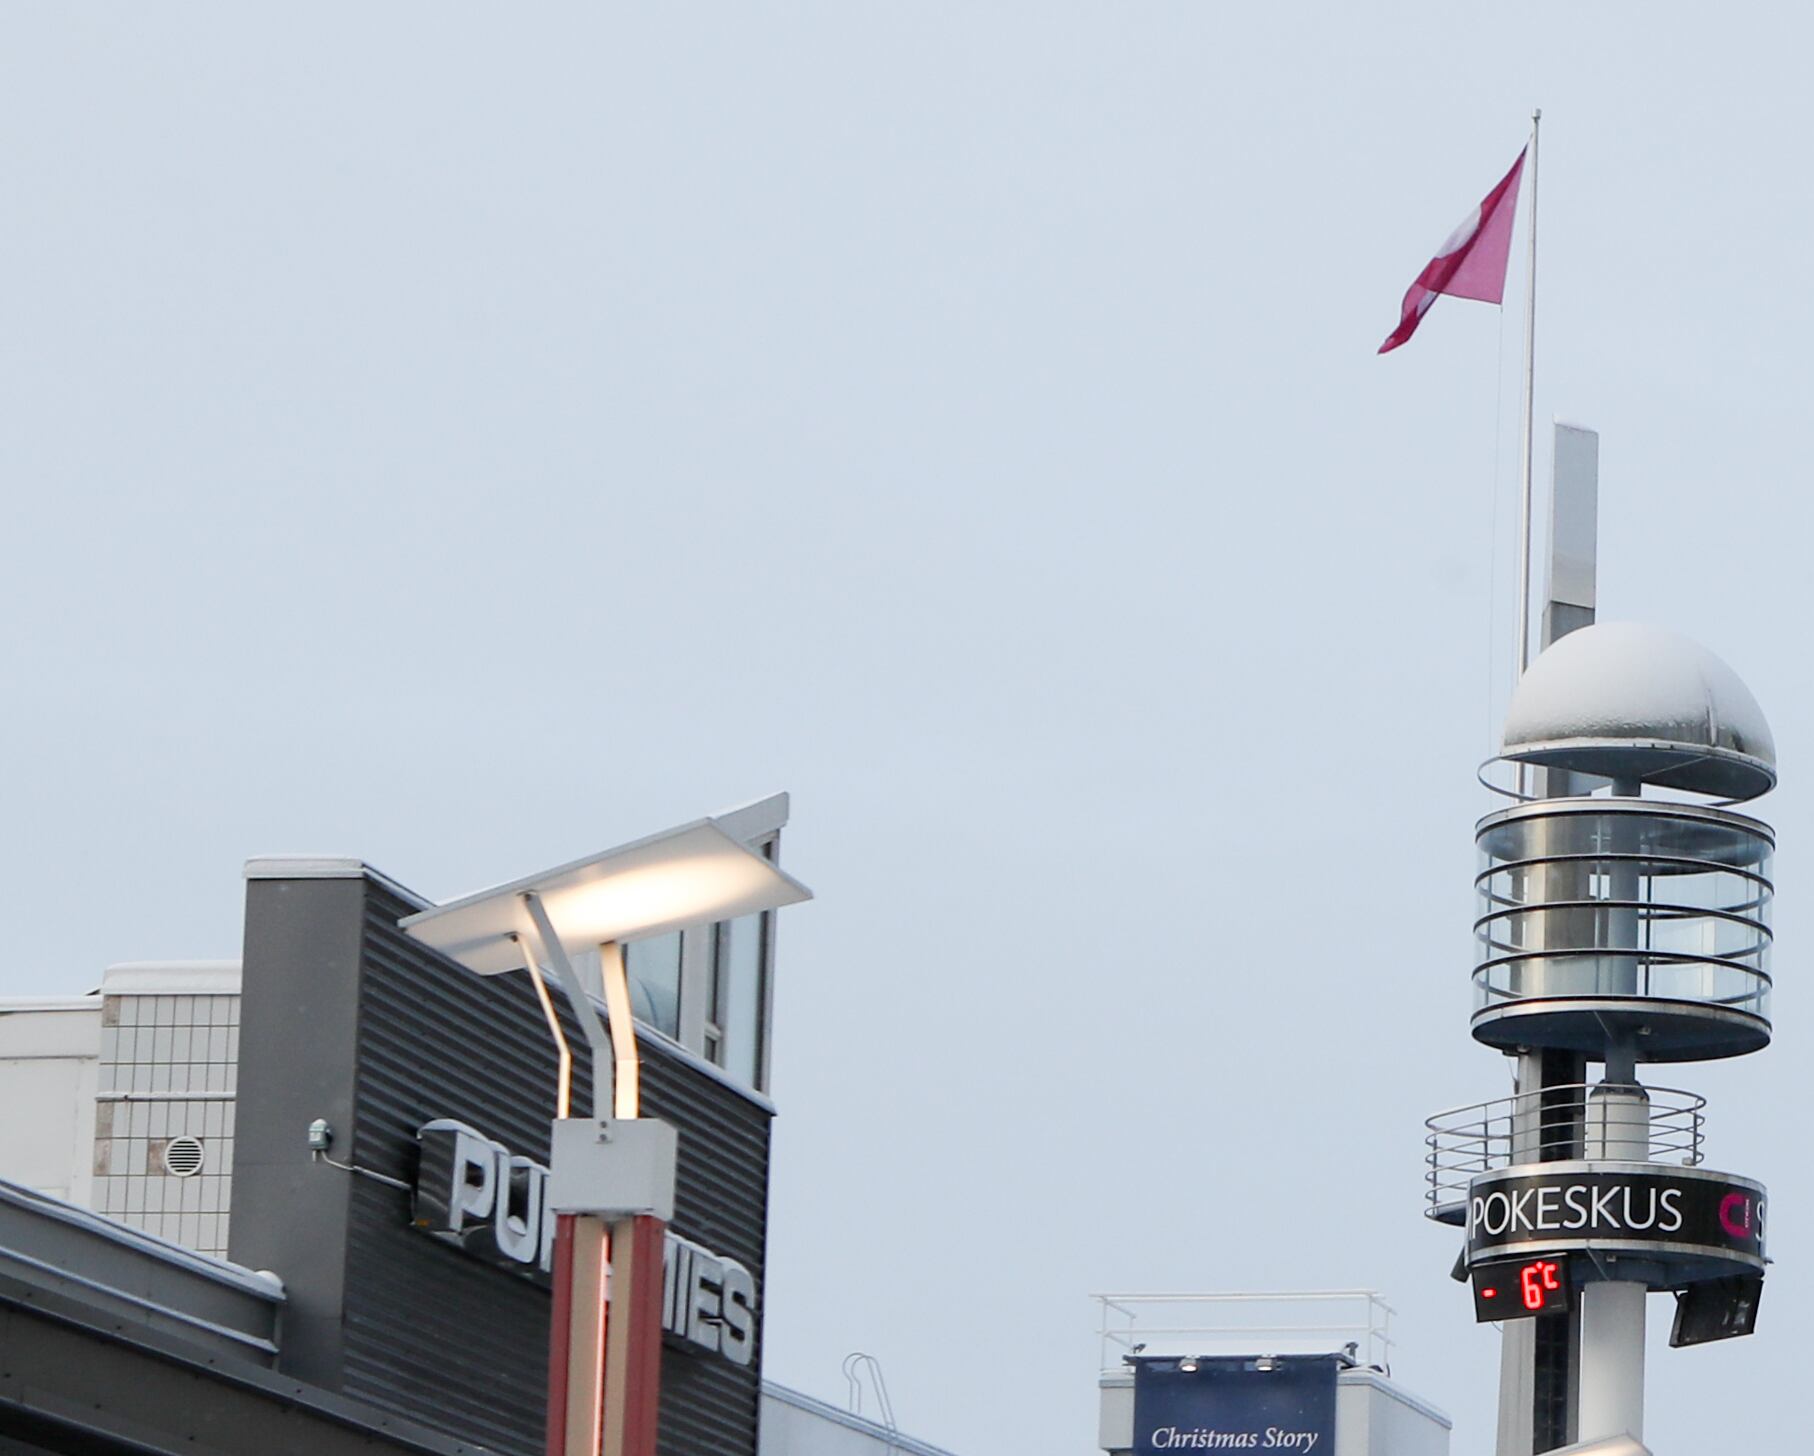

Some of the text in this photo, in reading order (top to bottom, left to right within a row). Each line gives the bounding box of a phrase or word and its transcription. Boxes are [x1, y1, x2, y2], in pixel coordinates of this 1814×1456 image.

[449, 1119, 756, 1366] PUIES
[1152, 1427, 1318, 1454] Christmas Story
